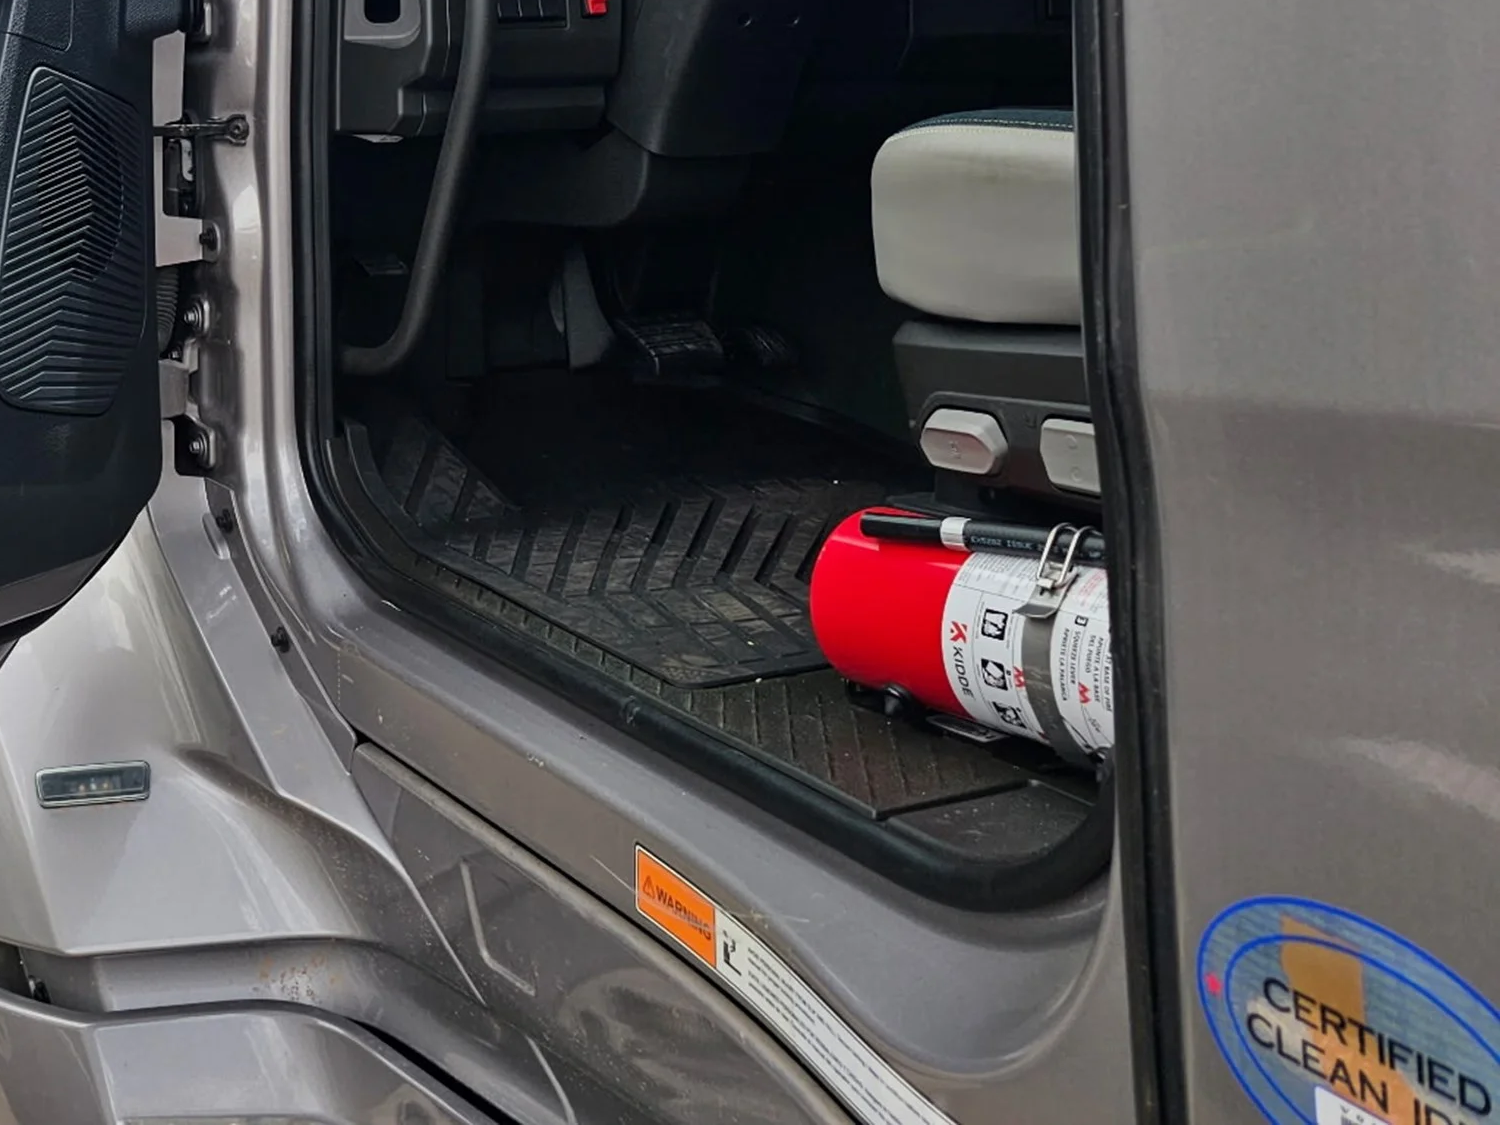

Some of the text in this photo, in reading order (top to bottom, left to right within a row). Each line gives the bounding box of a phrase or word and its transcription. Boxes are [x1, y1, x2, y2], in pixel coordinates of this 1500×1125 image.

[953, 646, 974, 699] KIDDE
[655, 884, 712, 941] WARNING
[1245, 1012, 1390, 1114] CLEAN
[1262, 977, 1492, 1117] CERTIFIED
